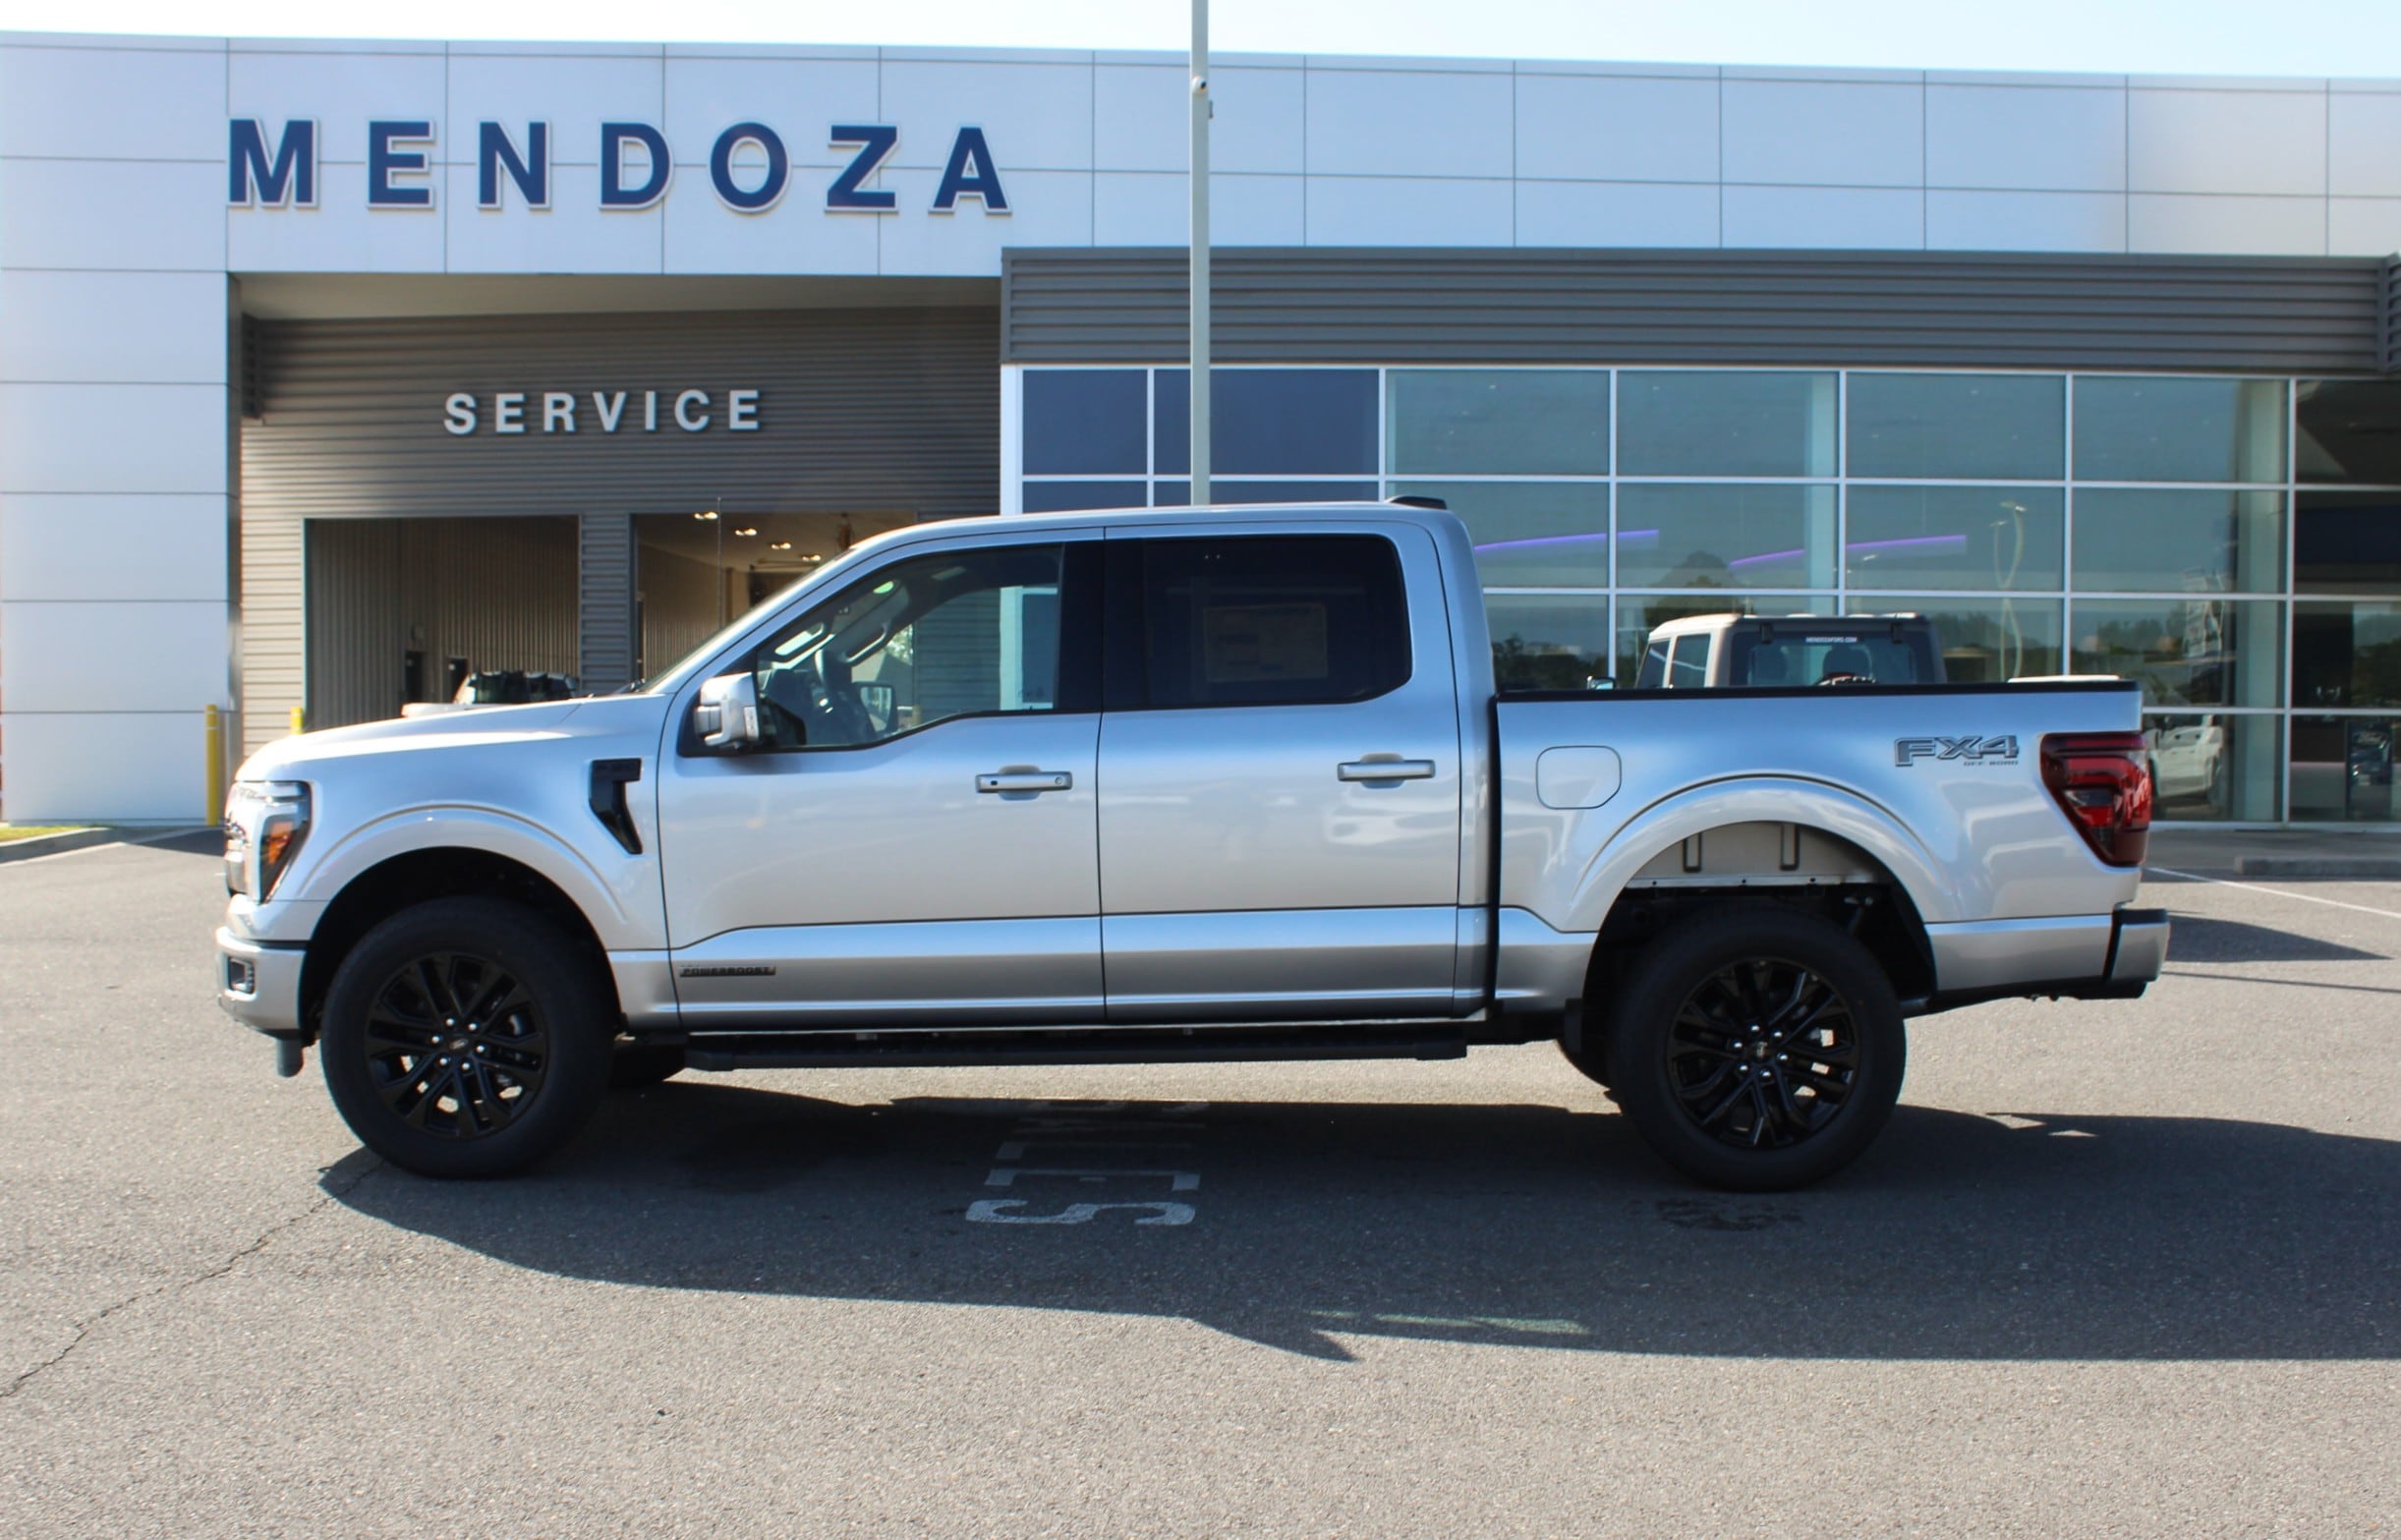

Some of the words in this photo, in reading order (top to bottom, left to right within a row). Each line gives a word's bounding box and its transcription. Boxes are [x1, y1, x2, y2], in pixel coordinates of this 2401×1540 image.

[227, 117, 1011, 214] MENDOZA
[442, 388, 761, 436] SERVICE
[1894, 734, 2020, 768] FX4
